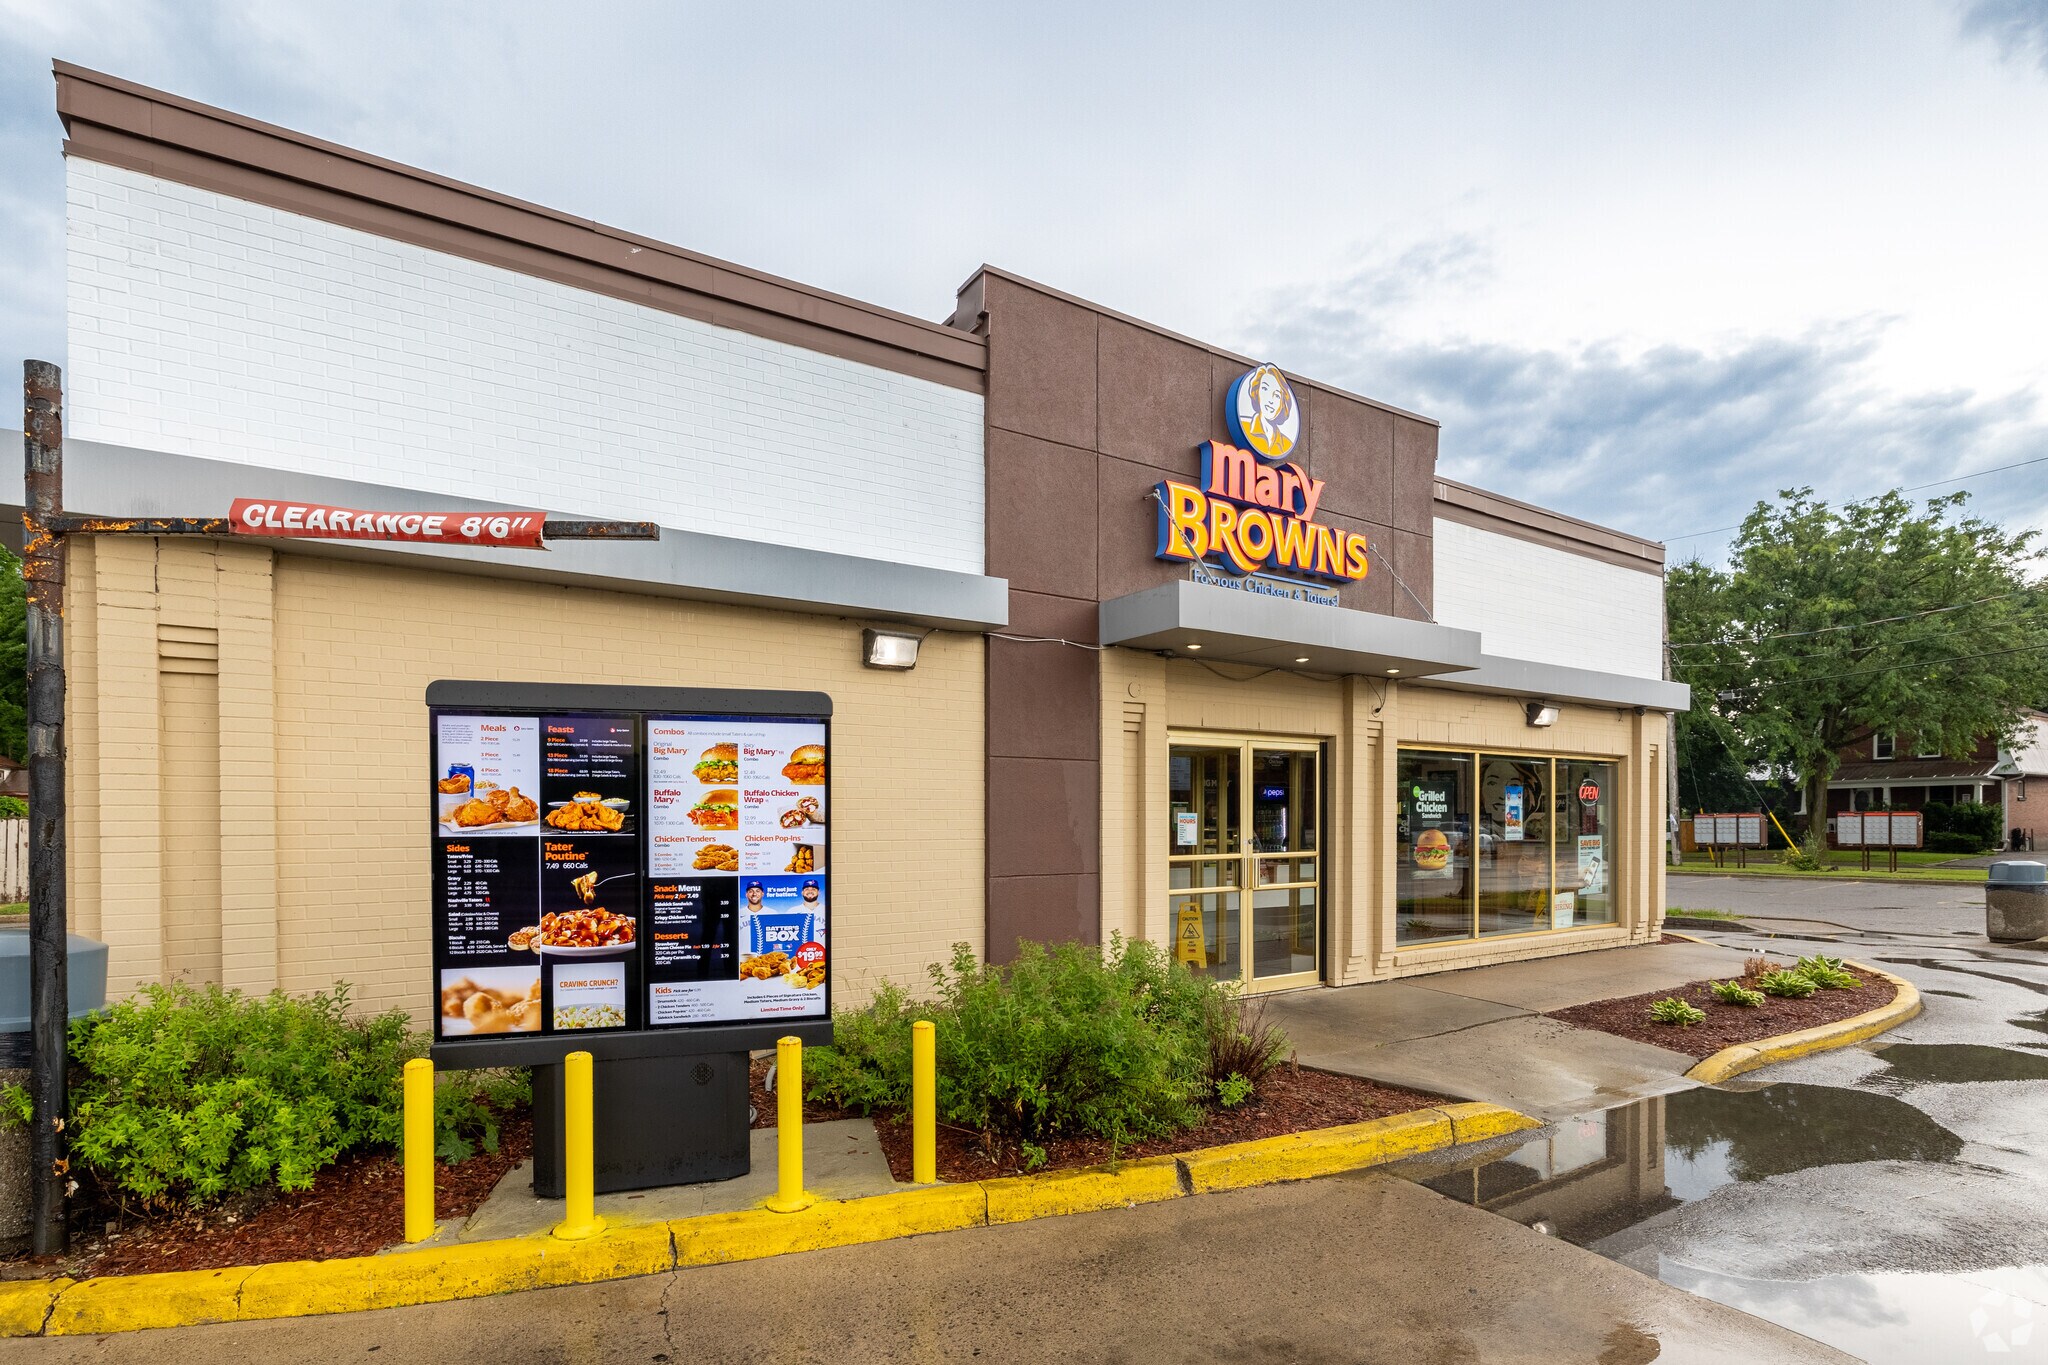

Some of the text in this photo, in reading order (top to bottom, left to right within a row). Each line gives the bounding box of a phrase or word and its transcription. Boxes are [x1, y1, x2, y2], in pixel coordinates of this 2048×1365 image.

[242, 503, 446, 536] CLEARANCE
[1165, 480, 1369, 581] BROWNS
[1246, 578, 1290, 599] Chicken
[1294, 589, 1300, 600] &
[667, 747, 687, 755] Mary
[1419, 791, 1445, 801] Grilled
[1579, 786, 1599, 799] OPEN
[1416, 802, 1447, 812] Chicken
[545, 842, 573, 851] Tater
[766, 930, 799, 942] BOX
